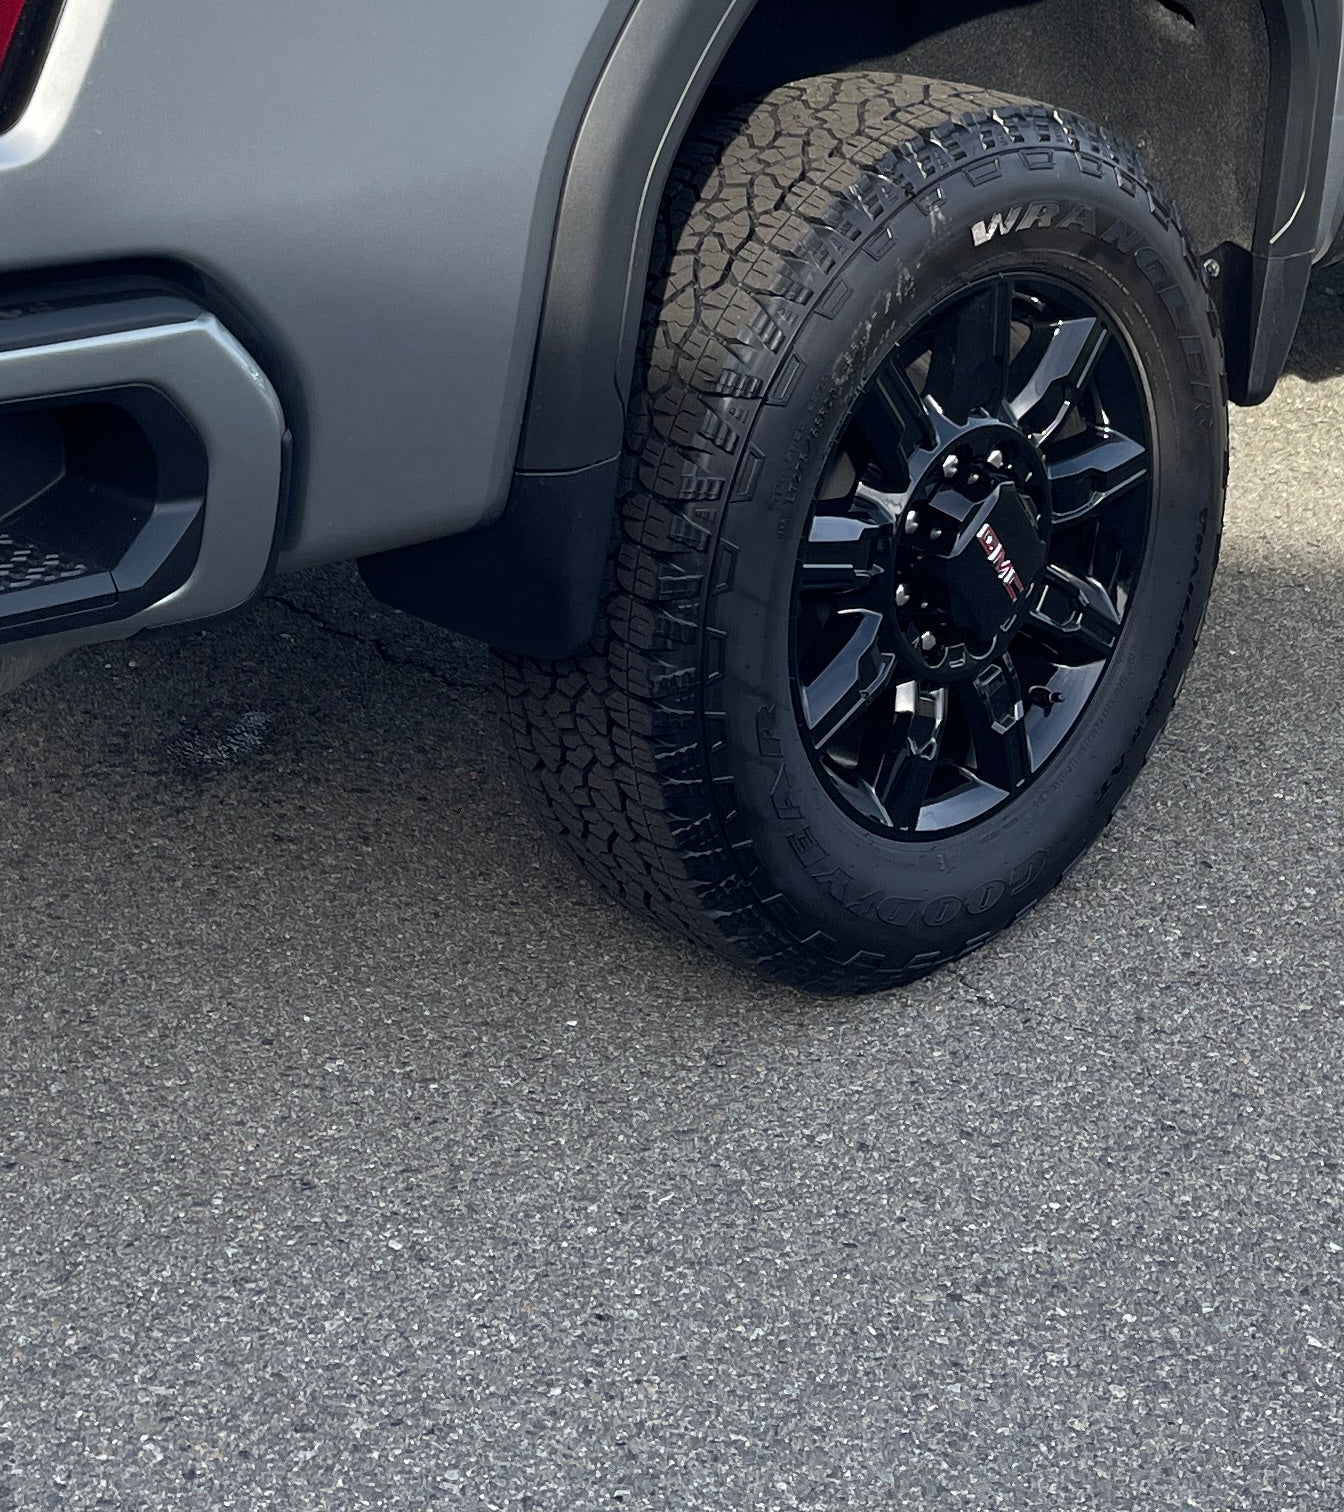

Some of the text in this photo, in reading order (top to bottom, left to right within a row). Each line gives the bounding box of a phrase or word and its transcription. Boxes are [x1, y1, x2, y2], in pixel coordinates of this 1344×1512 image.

[970, 199, 1214, 430] WRANGLER
[975, 522, 1025, 603] GMC
[755, 702, 1049, 928] GOODYEAR
